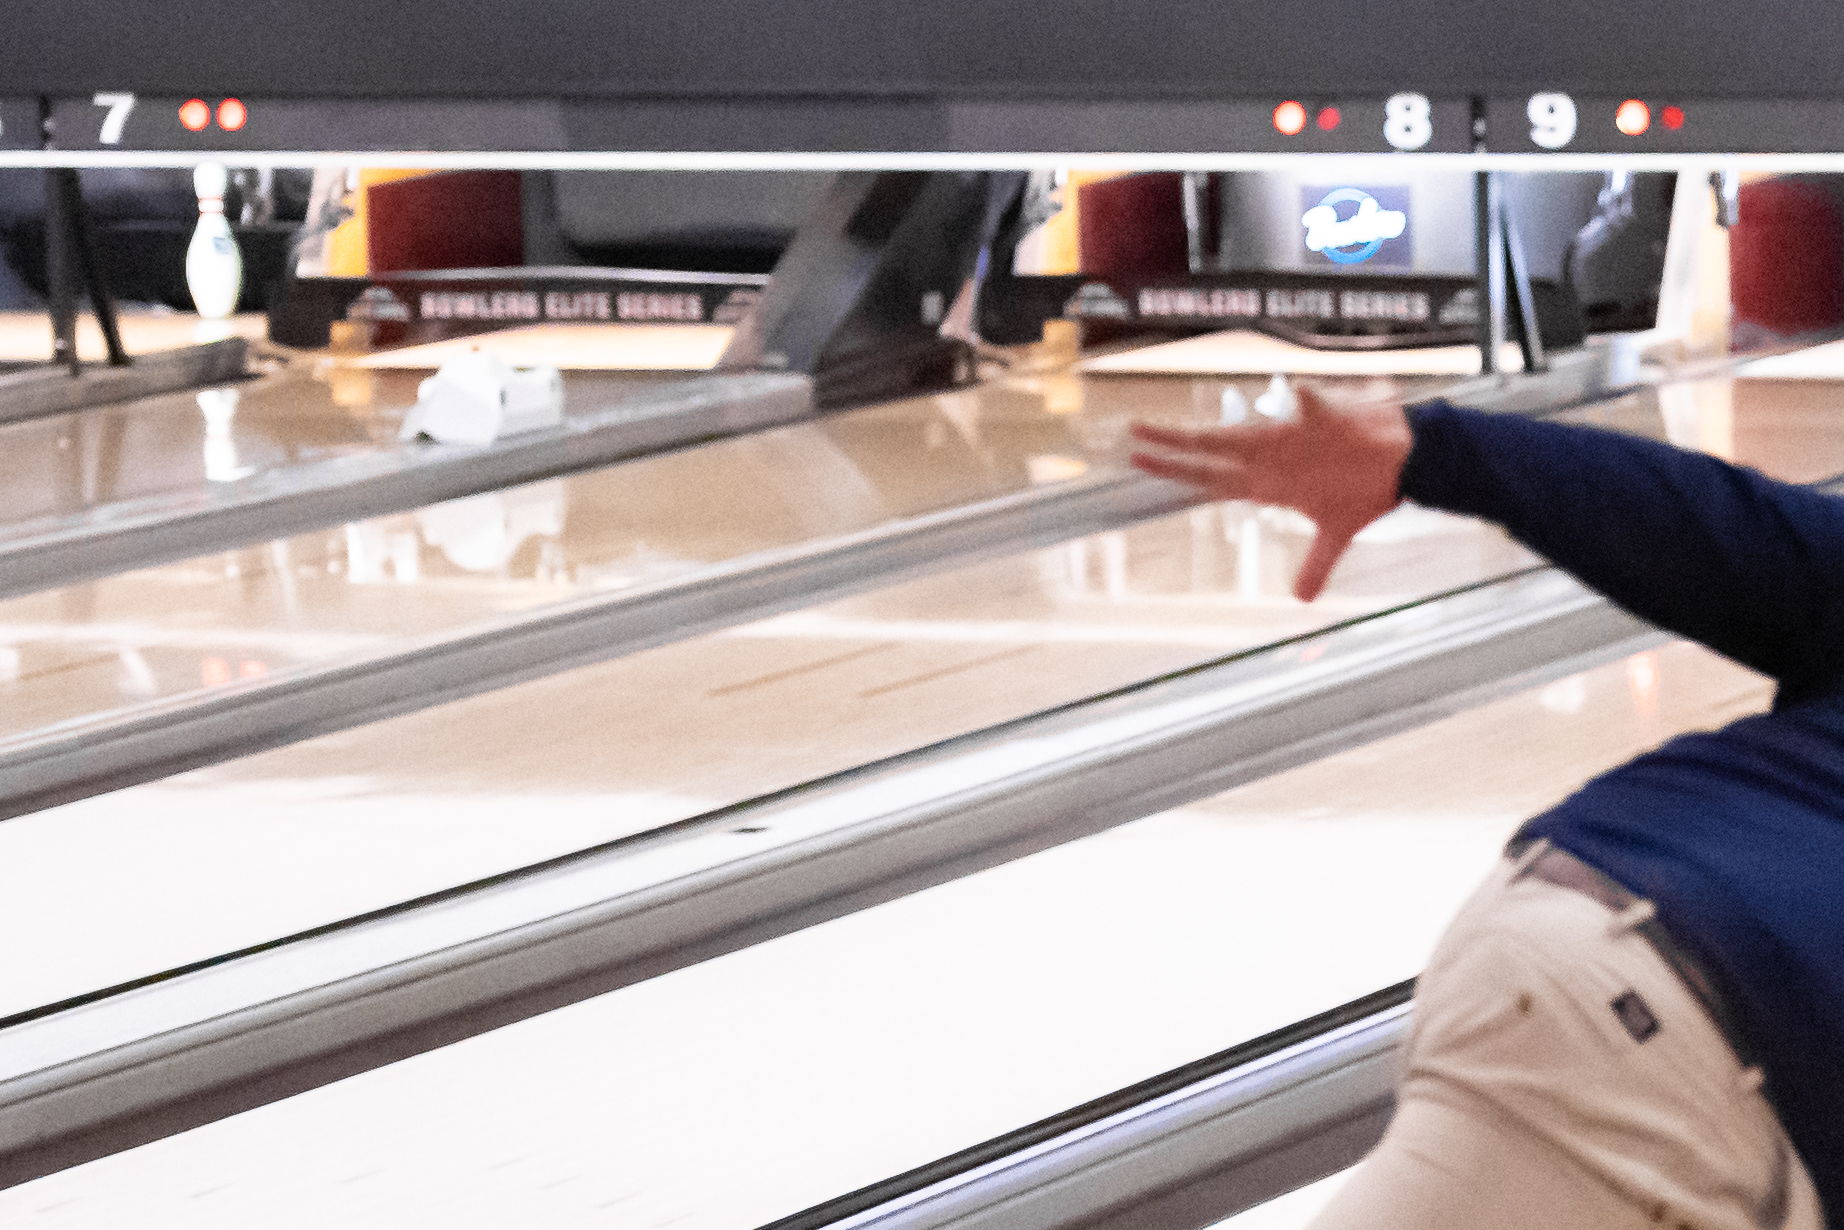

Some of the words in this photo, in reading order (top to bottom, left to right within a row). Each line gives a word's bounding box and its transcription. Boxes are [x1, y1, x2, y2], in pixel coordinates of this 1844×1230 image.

[93, 91, 135, 144] 7
[1384, 91, 1432, 149] 8
[1527, 91, 1577, 149] 9
